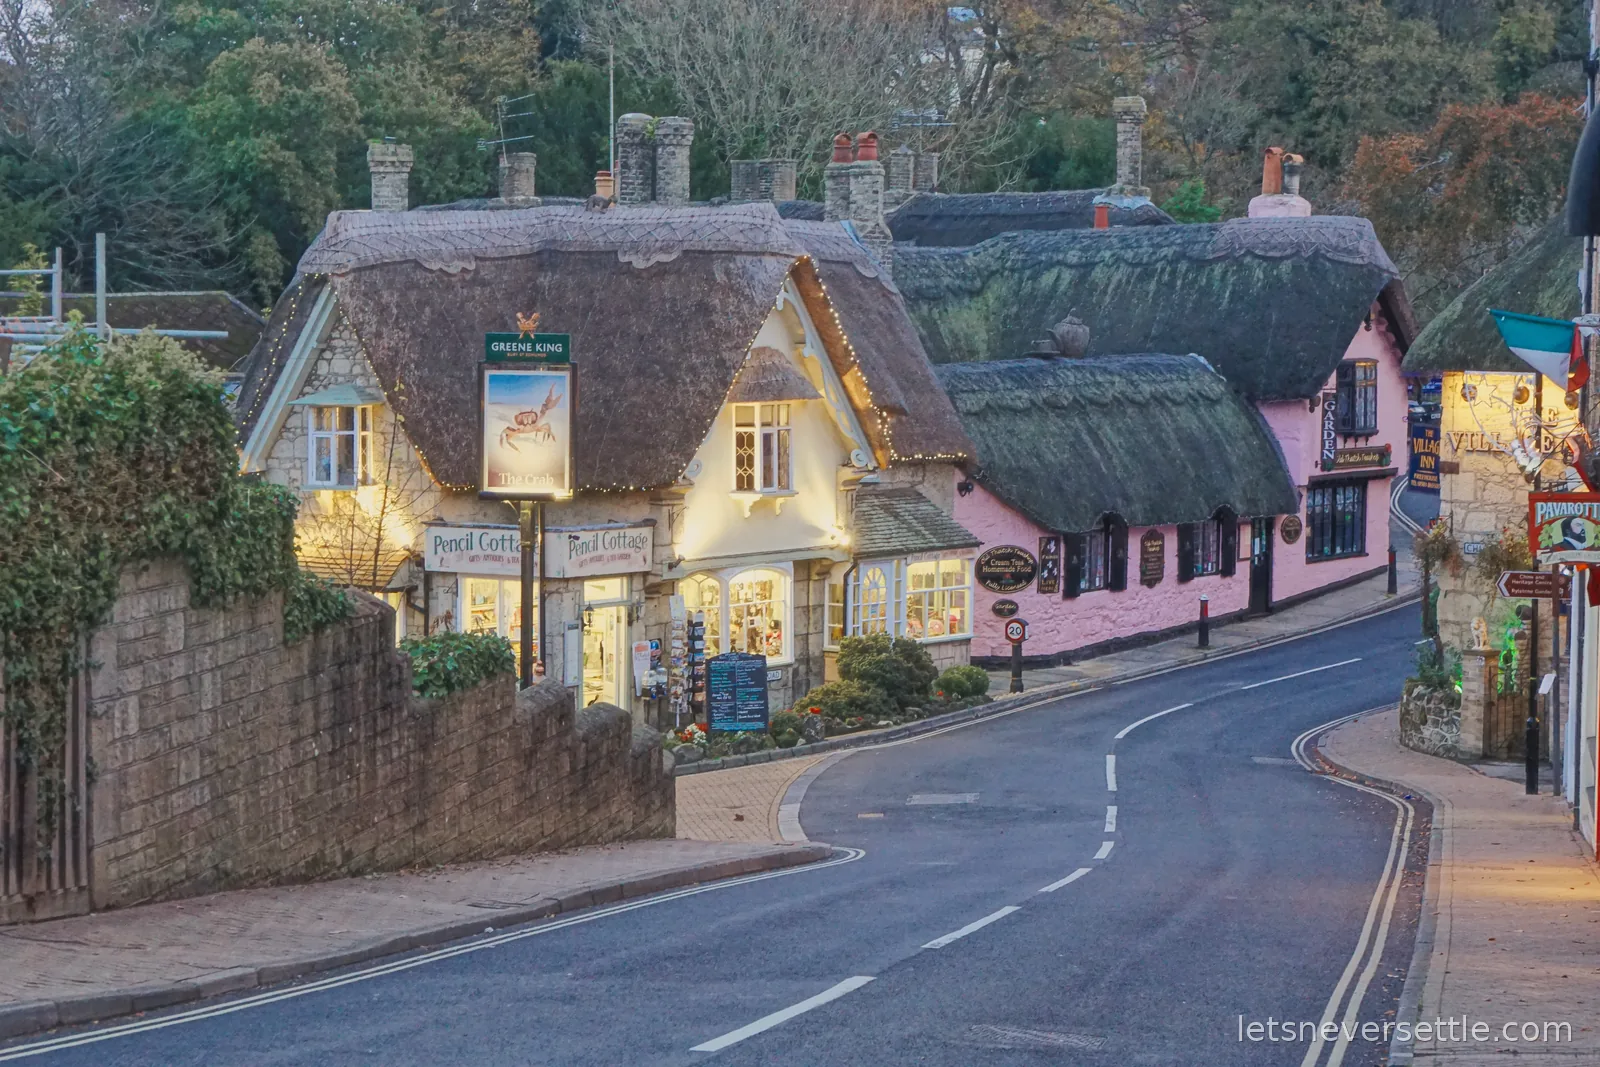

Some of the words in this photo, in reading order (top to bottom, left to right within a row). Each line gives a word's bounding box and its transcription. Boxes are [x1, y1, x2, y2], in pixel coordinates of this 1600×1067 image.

[491, 342, 533, 352] GREENE
[535, 343, 563, 353] KING
[1323, 400, 1336, 460] GARDEN
[1425, 429, 1434, 438] THE
[1413, 437, 1440, 455] VILLAG
[1446, 431, 1555, 454] VILLE
[1420, 455, 1435, 469] INN
[498, 472, 522, 485] The
[525, 473, 554, 485] Crab
[1535, 502, 1600, 525] PAVAROTT
[434, 532, 473, 555] Pencil
[479, 532, 540, 554] Cottae
[568, 533, 599, 560] Pencil
[603, 531, 648, 553] Cottage
[983, 565, 1016, 573] Homemade
[1017, 564, 1032, 573] Food
[991, 558, 1010, 566] Cream
[1011, 558, 1025, 566] Teas
[1009, 626, 1022, 636] 20
